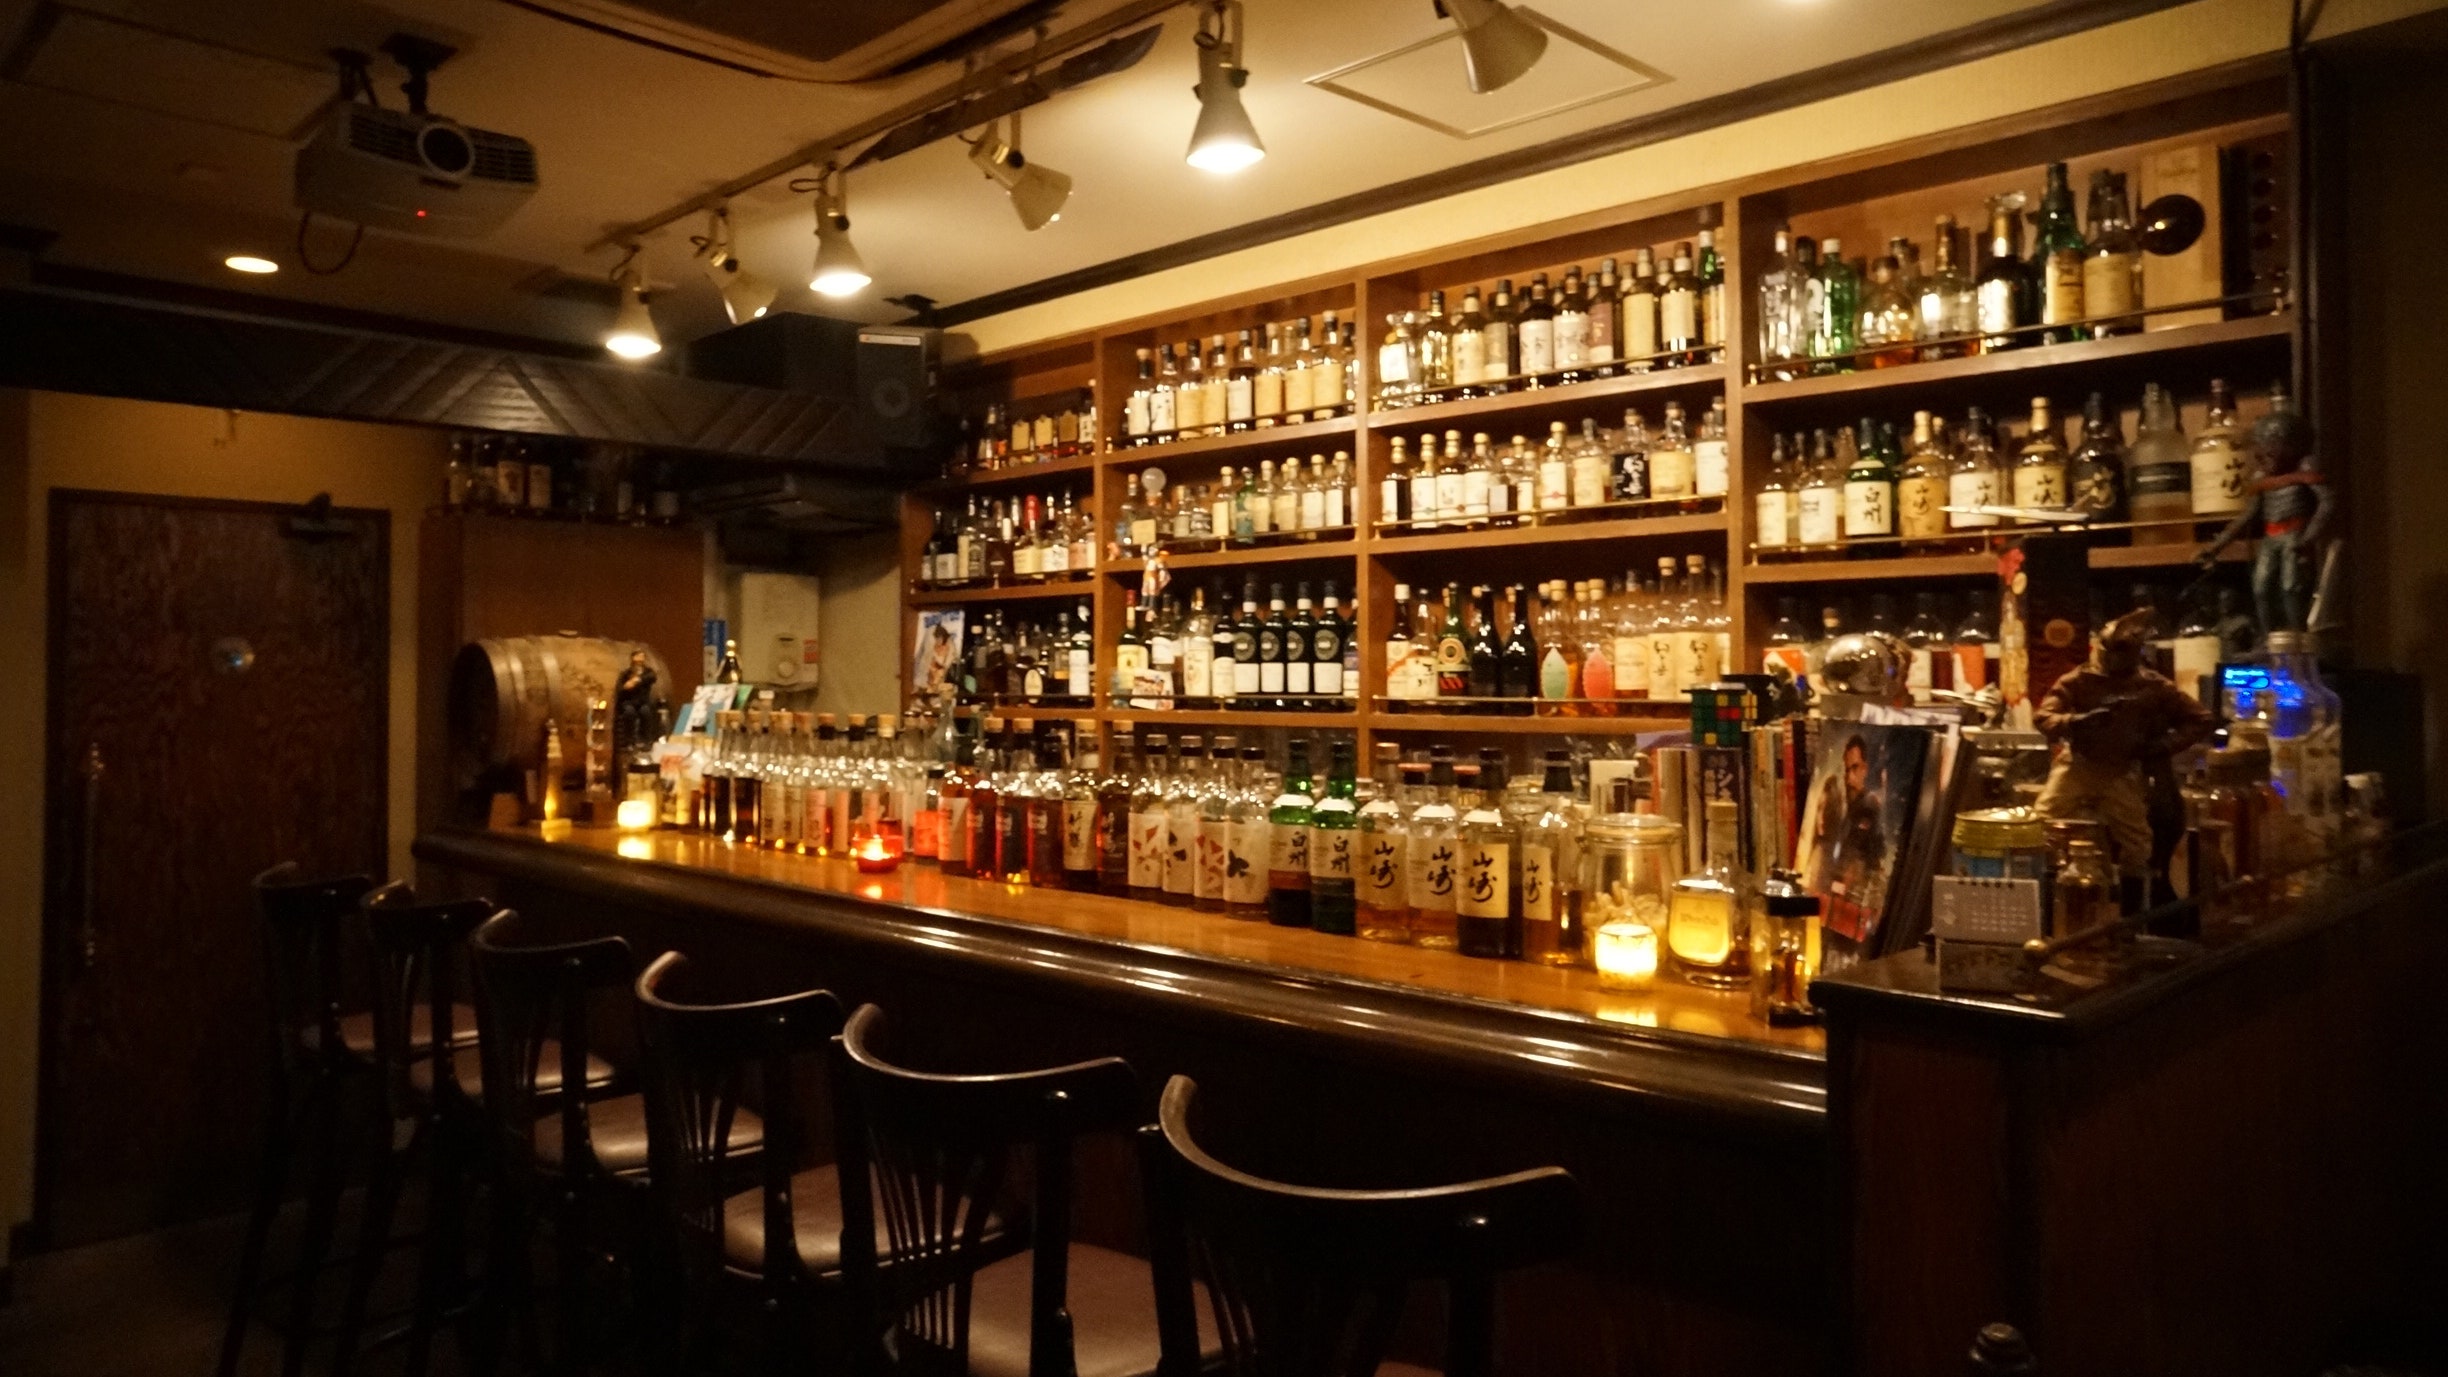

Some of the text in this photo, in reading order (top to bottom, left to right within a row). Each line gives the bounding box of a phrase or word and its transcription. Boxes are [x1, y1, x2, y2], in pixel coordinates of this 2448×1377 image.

[1862, 487, 1881, 524] 白州
[1288, 831, 1308, 869] 白州
[1330, 836, 1350, 873] 白州
[1369, 841, 1399, 889] 山崎
[1427, 846, 1457, 895] 山崎
[1468, 851, 1497, 903] 山崎
